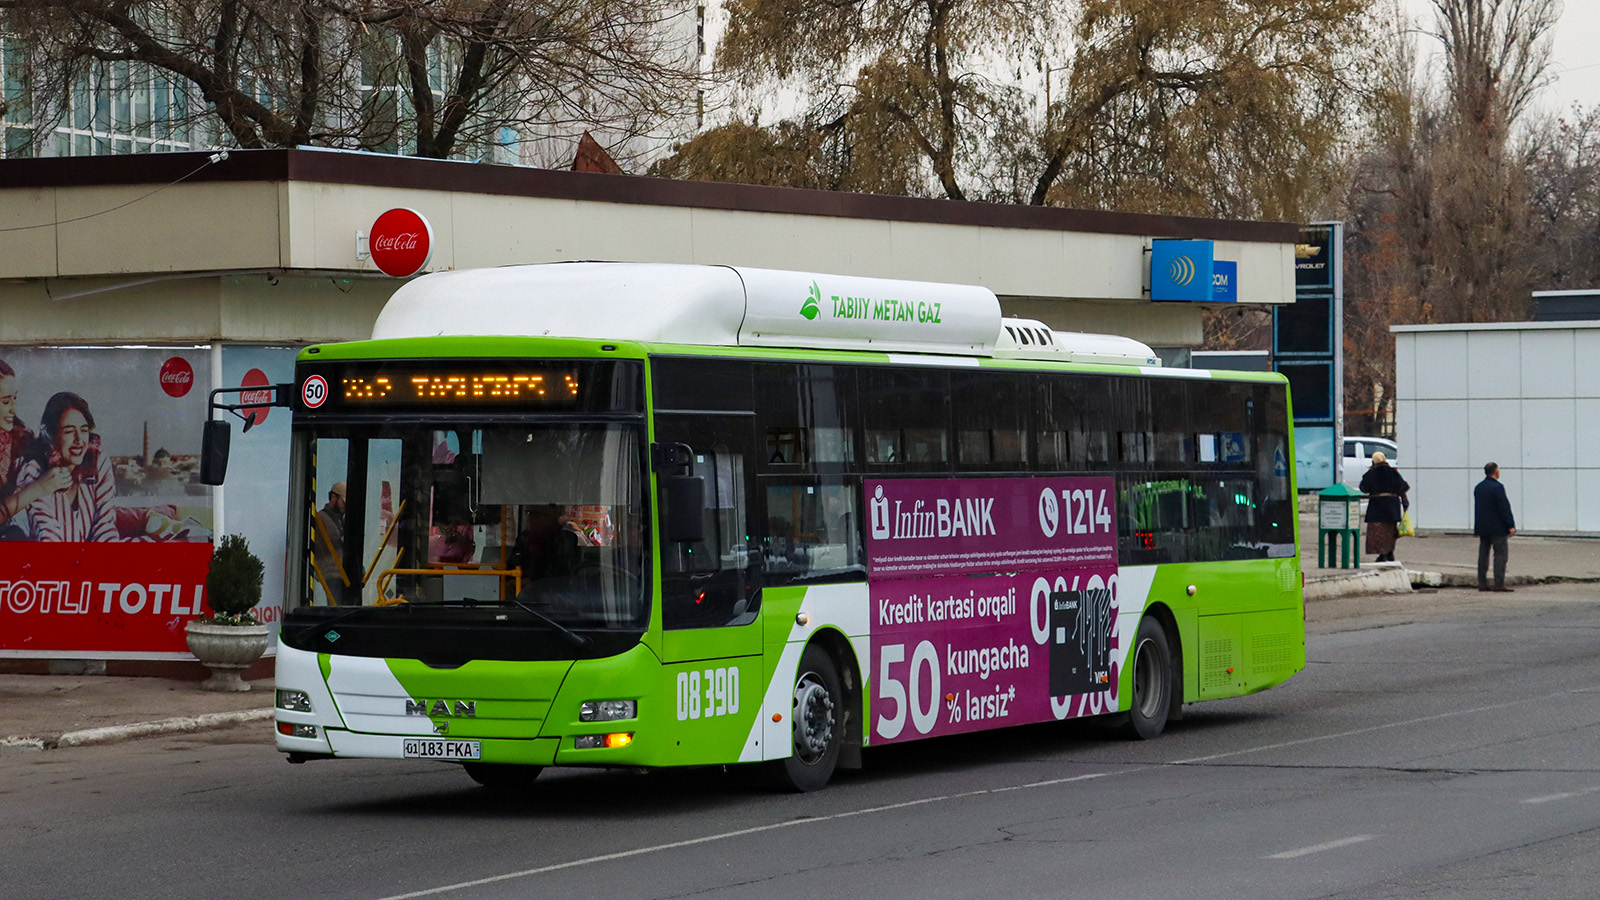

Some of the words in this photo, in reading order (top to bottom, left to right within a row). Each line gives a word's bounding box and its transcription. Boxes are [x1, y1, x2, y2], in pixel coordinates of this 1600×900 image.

[831, 296, 870, 320] TABIIY
[873, 299, 914, 322] METAN
[918, 301, 942, 324] GAZ
[306, 384, 324, 399] 50
[893, 497, 996, 540] InfinBANK
[1062, 488, 1112, 535] 1214
[98, 583, 204, 615] TOTLI
[878, 594, 924, 626] Kredit
[927, 589, 974, 622] kartasi
[977, 587, 1016, 622] orqali
[947, 638, 1030, 680] kungacha
[406, 700, 476, 716] MAN
[677, 671, 701, 721] 08
[704, 666, 740, 718] 390
[876, 640, 942, 739] 50
[420, 742, 443, 756] 183
[446, 742, 472, 757] FKA
